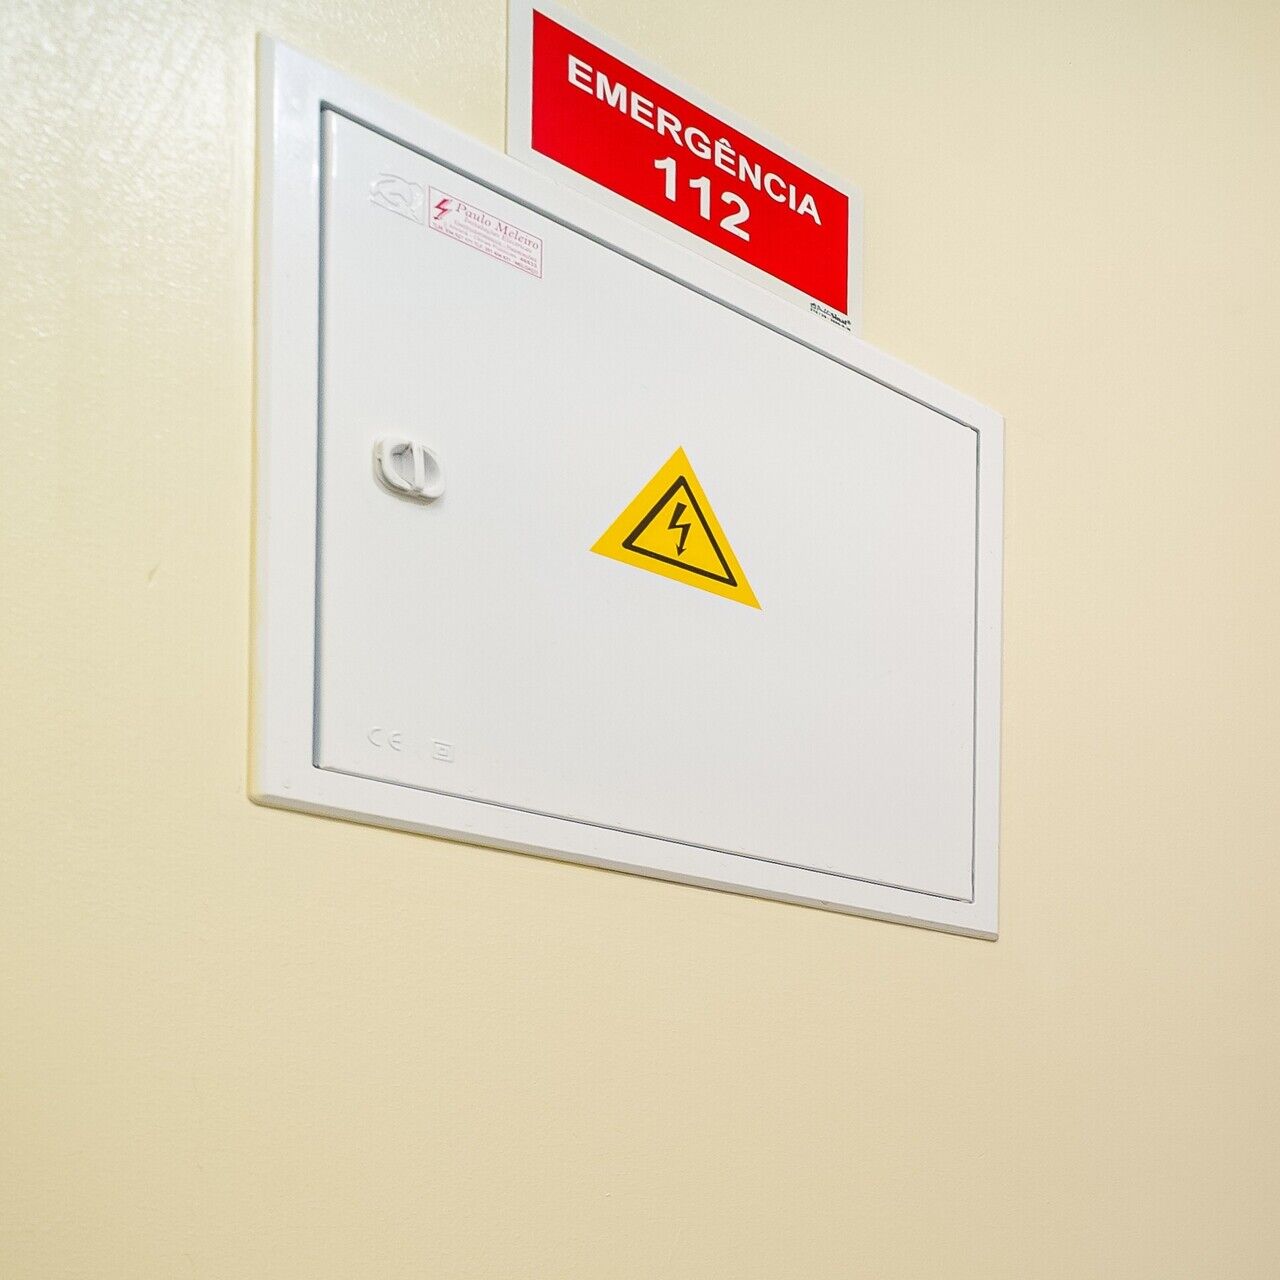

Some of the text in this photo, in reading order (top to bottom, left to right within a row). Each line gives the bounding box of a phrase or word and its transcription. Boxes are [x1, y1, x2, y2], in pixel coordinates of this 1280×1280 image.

[567, 53, 822, 226] EMERGÊNCIA
[456, 203, 492, 227] Paulo
[495, 221, 539, 250] Meleiro
[654, 156, 751, 243] 112
